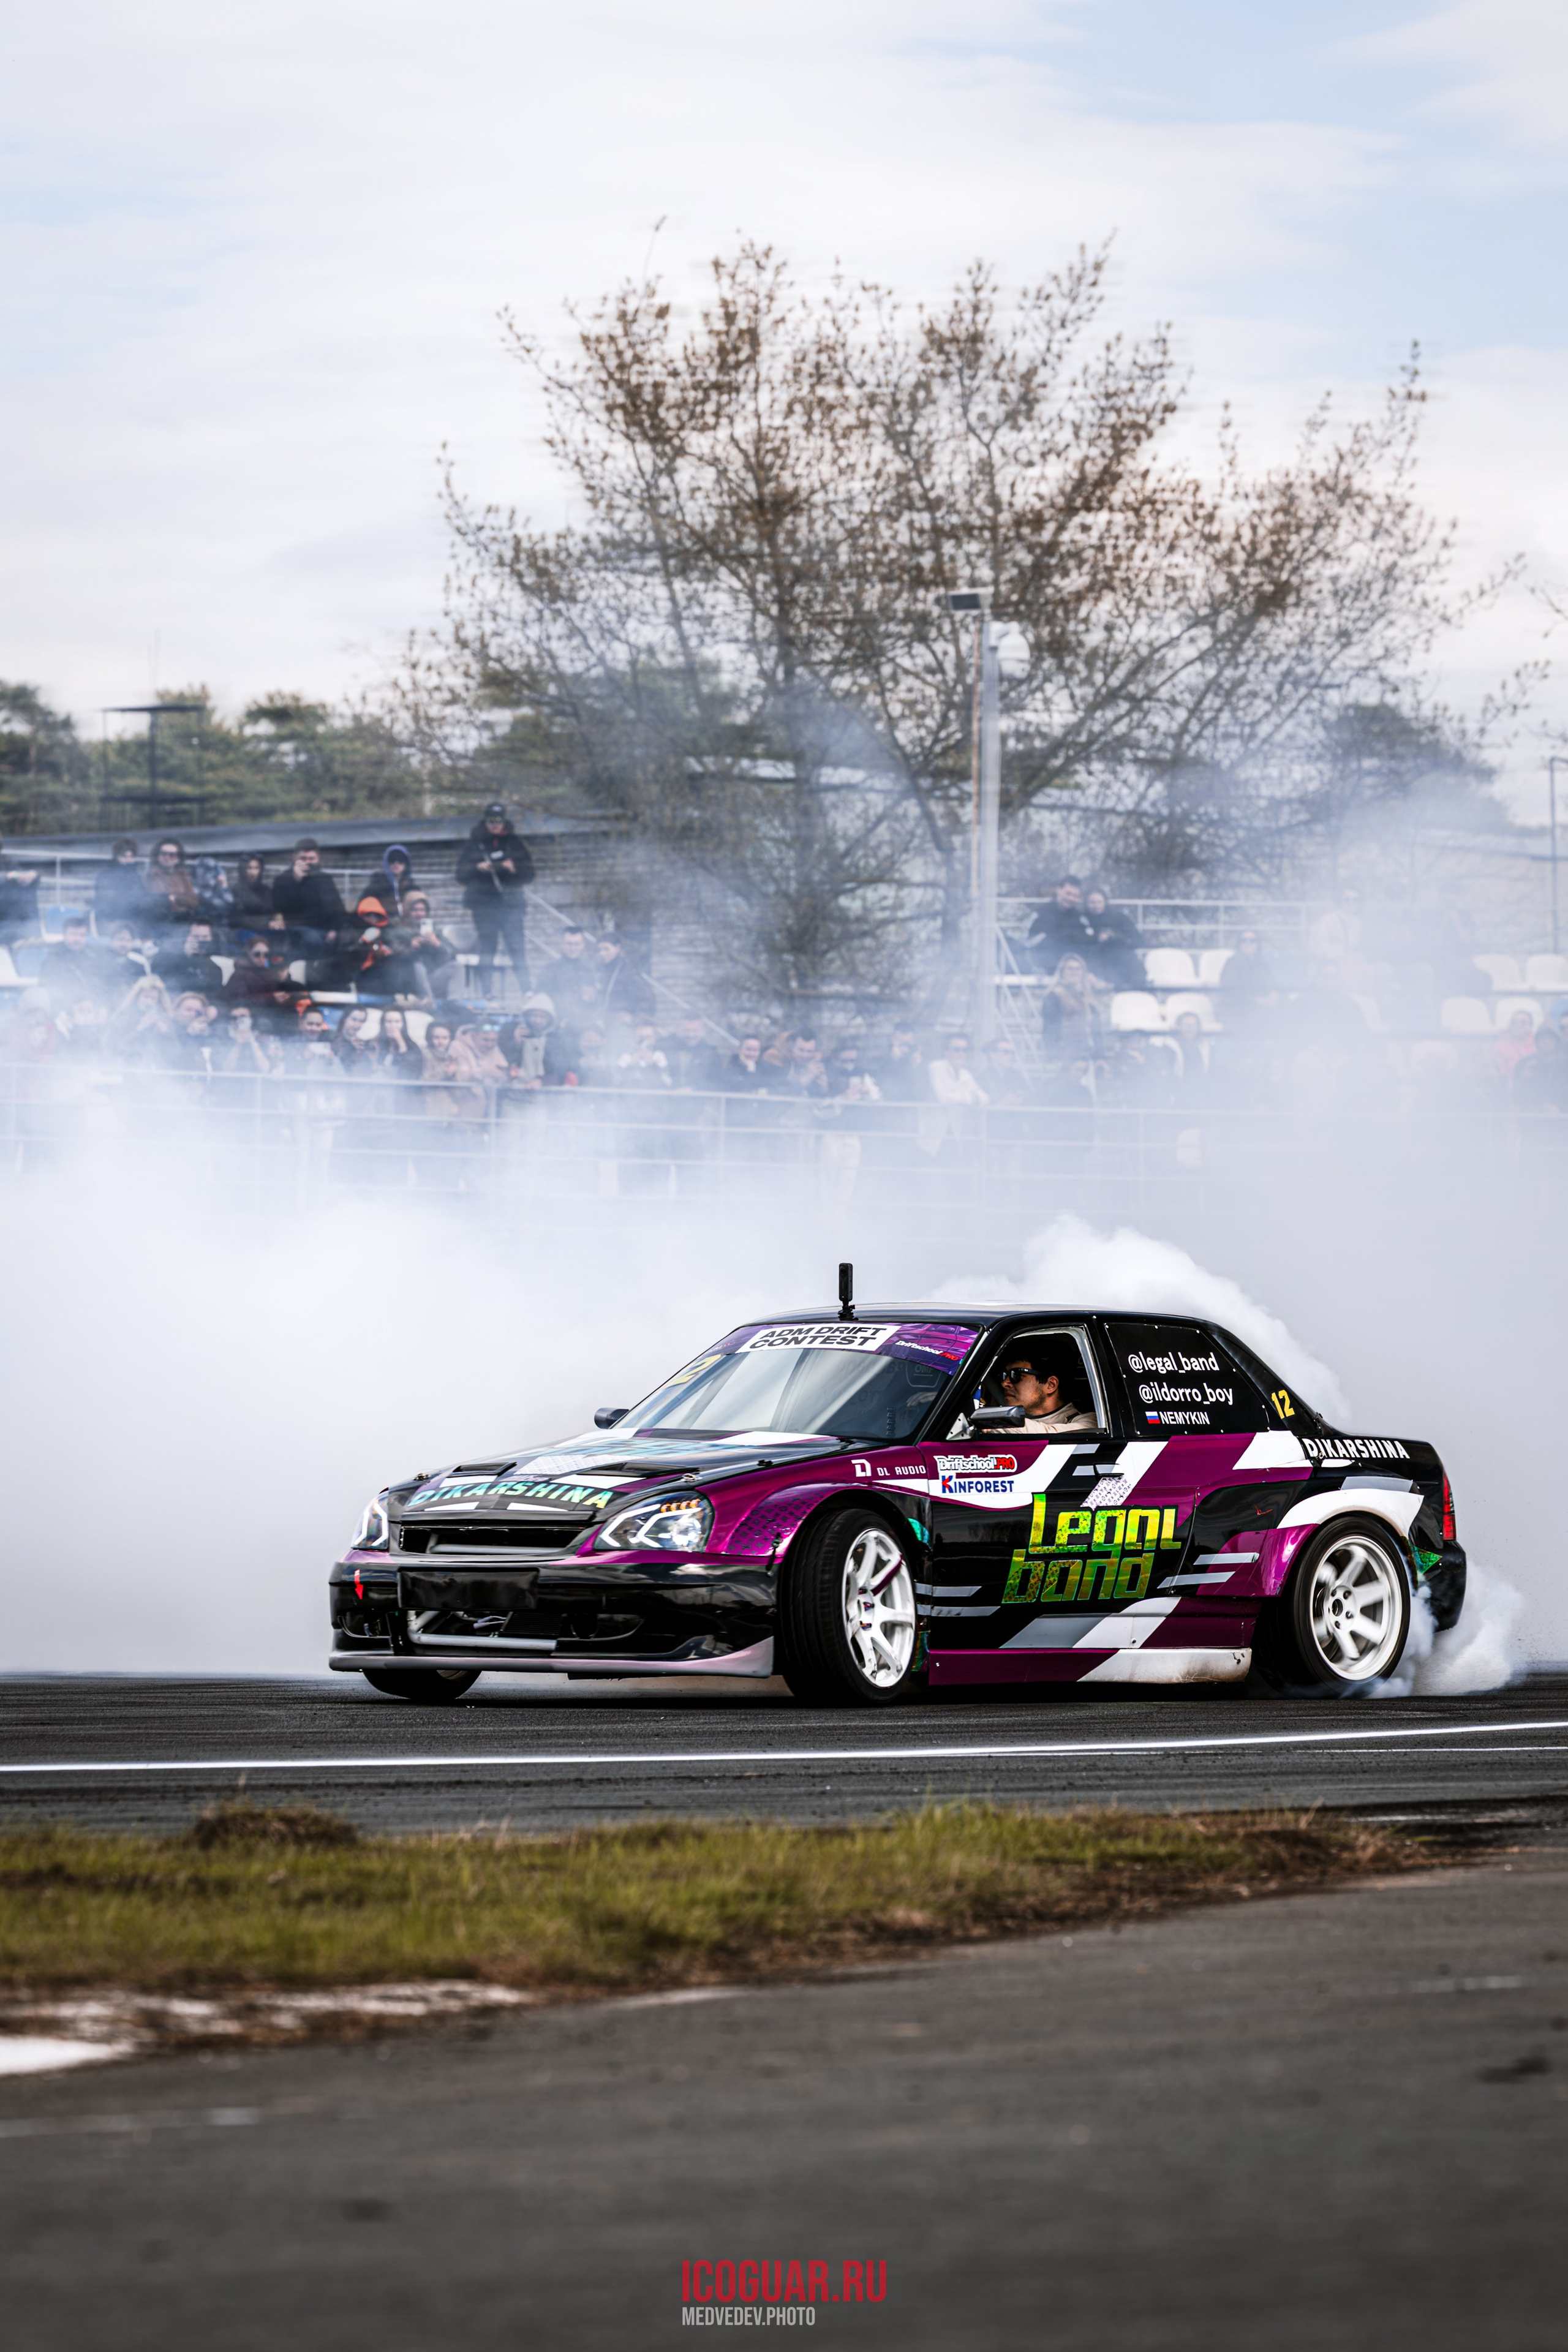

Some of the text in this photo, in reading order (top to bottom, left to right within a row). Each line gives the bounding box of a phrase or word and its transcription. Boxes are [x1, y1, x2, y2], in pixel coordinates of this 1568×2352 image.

[749, 1335, 877, 1349] CONTEST
[760, 1326, 888, 1340] ADM DRIFT
[895, 1340, 960, 1361] Driftschool.PRO
[1128, 1351, 1220, 1374] @legal_band
[1138, 1382, 1234, 1406] @ildorro_boy
[1270, 1389, 1295, 1420] 12
[1159, 1411, 1210, 1425] NEMYKIN
[1302, 1438, 1411, 1459] DIKARSHINA
[877, 1468, 891, 1476] DL
[895, 1465, 927, 1476] AUDIO
[937, 1456, 1016, 1472] Driftschool.PRO
[407, 1481, 614, 1509] DIKARSHINA
[941, 1475, 1015, 1494] KINFOREST
[1028, 1493, 1182, 1556] Legal
[1001, 1548, 1155, 1604] band
